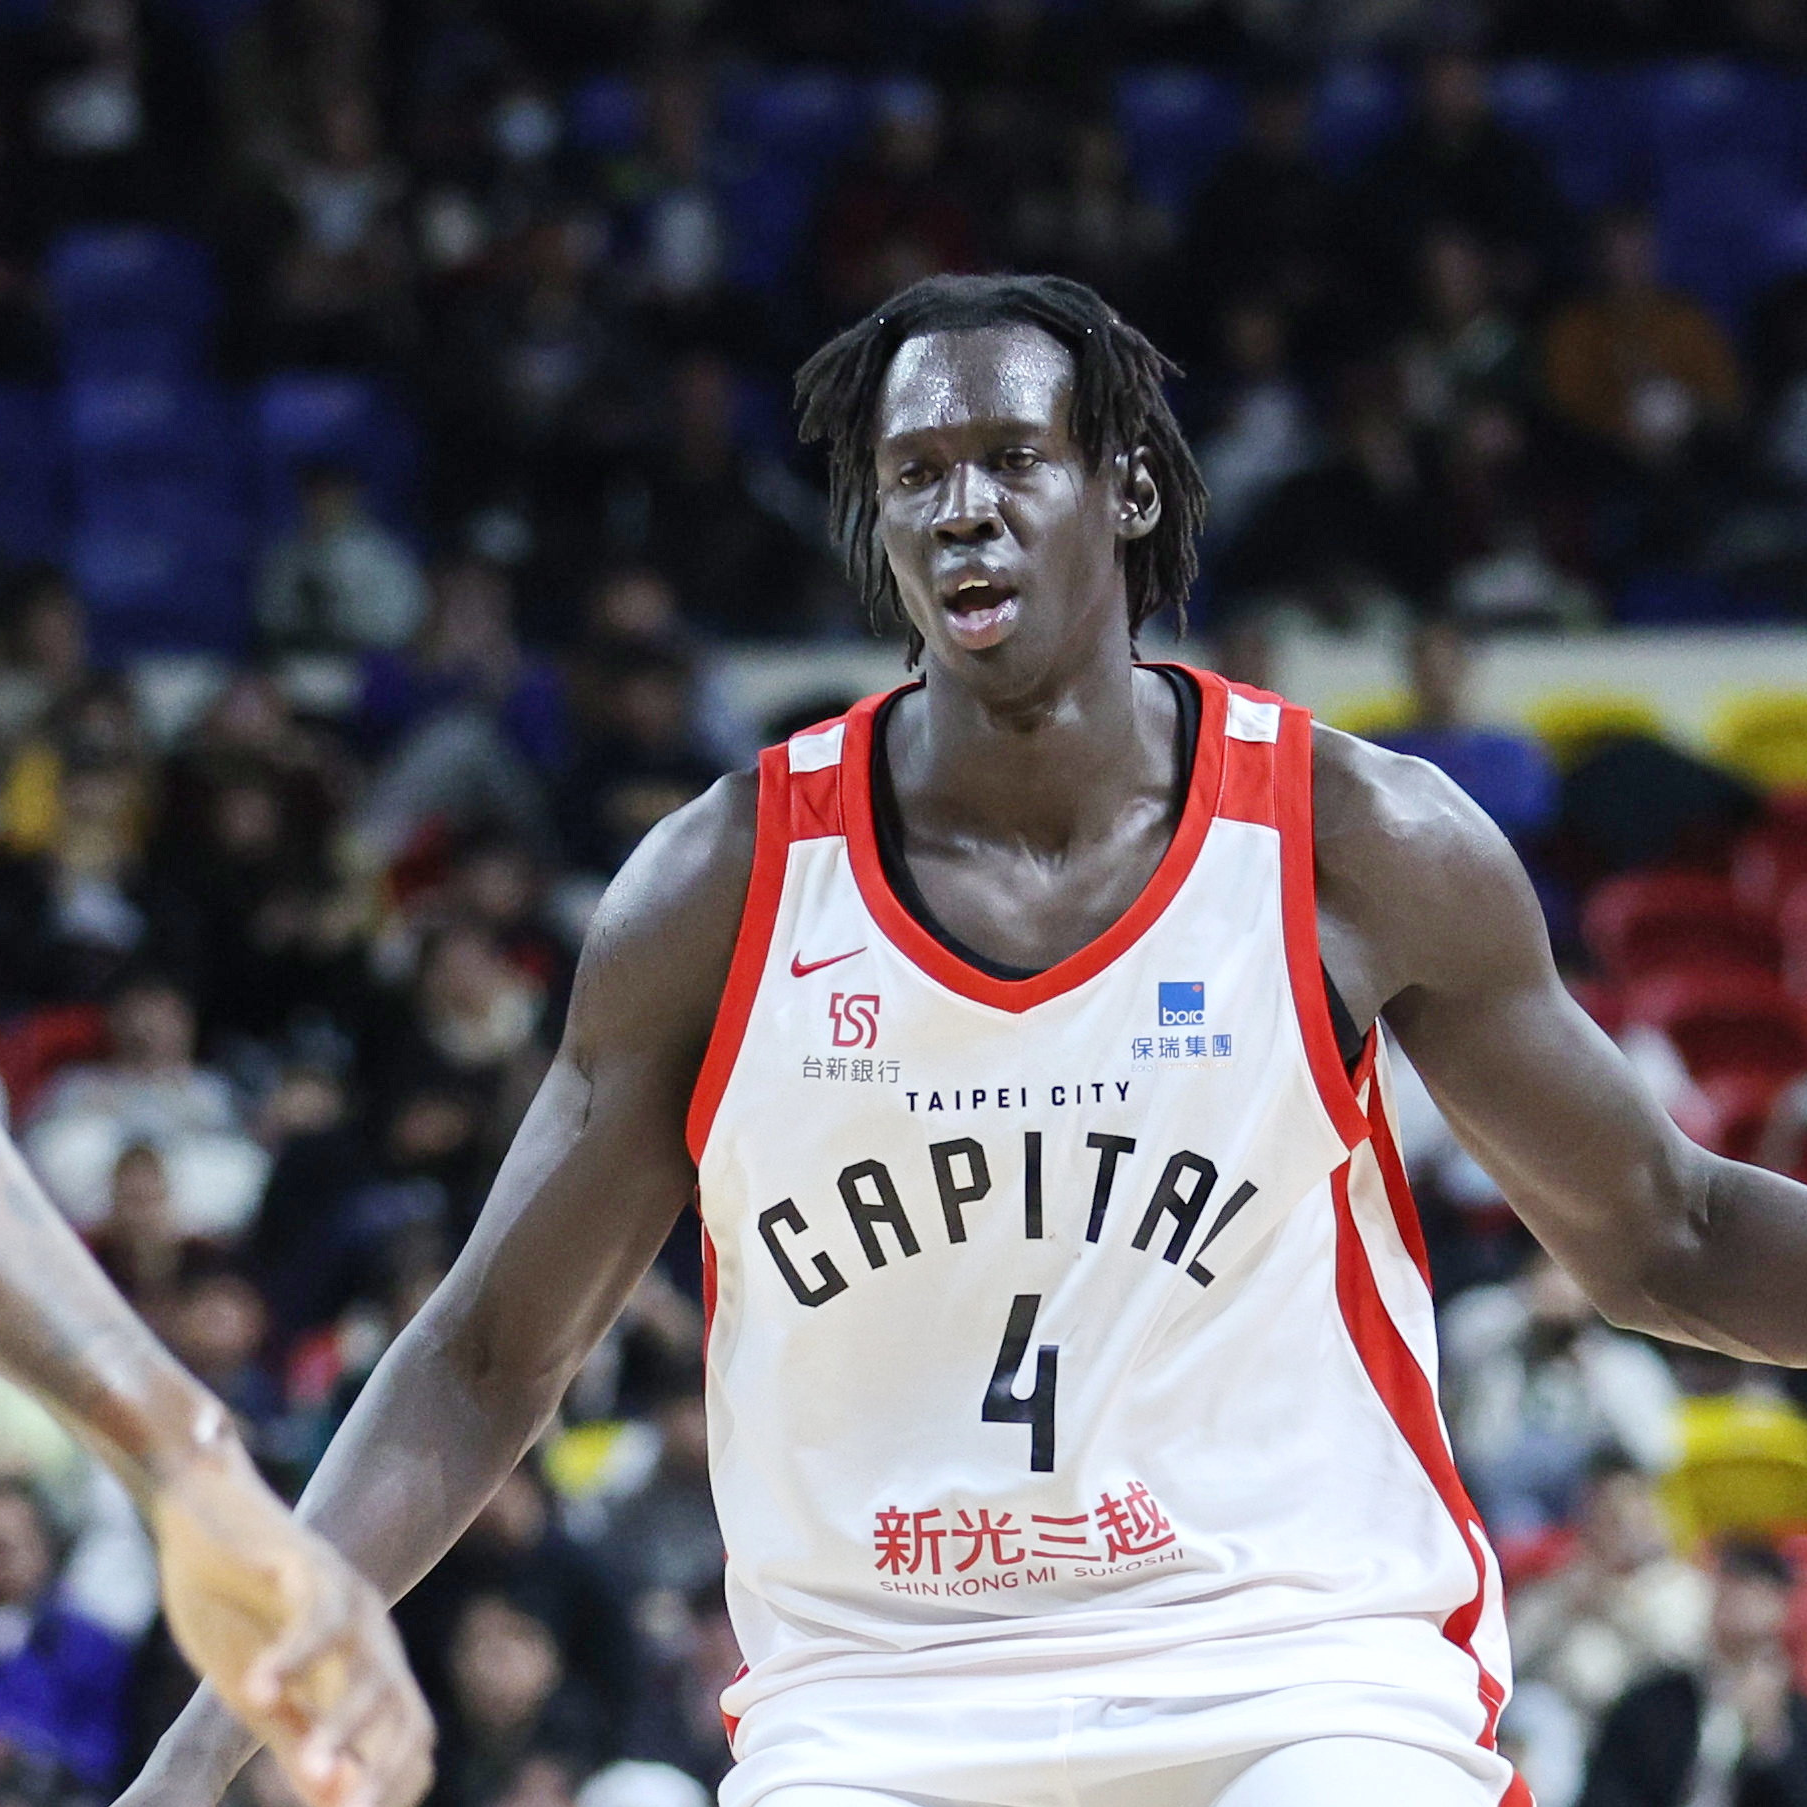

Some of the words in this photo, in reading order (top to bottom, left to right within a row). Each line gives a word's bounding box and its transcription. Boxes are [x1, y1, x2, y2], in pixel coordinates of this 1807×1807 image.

[801, 1055, 901, 1084] 台新銀行
[1131, 1033, 1232, 1060] 保瑞集團
[905, 1086, 1027, 1112] TAIPEI
[1050, 1080, 1130, 1107] CITY
[757, 1130, 1259, 1308] CAPITAL
[981, 1293, 1060, 1473] 4
[873, 1480, 1176, 1576] 新光三越
[879, 1580, 939, 1596] SHIN
[945, 1571, 1019, 1597] KONG
[1026, 1548, 1184, 1585] MISUKOSHI
